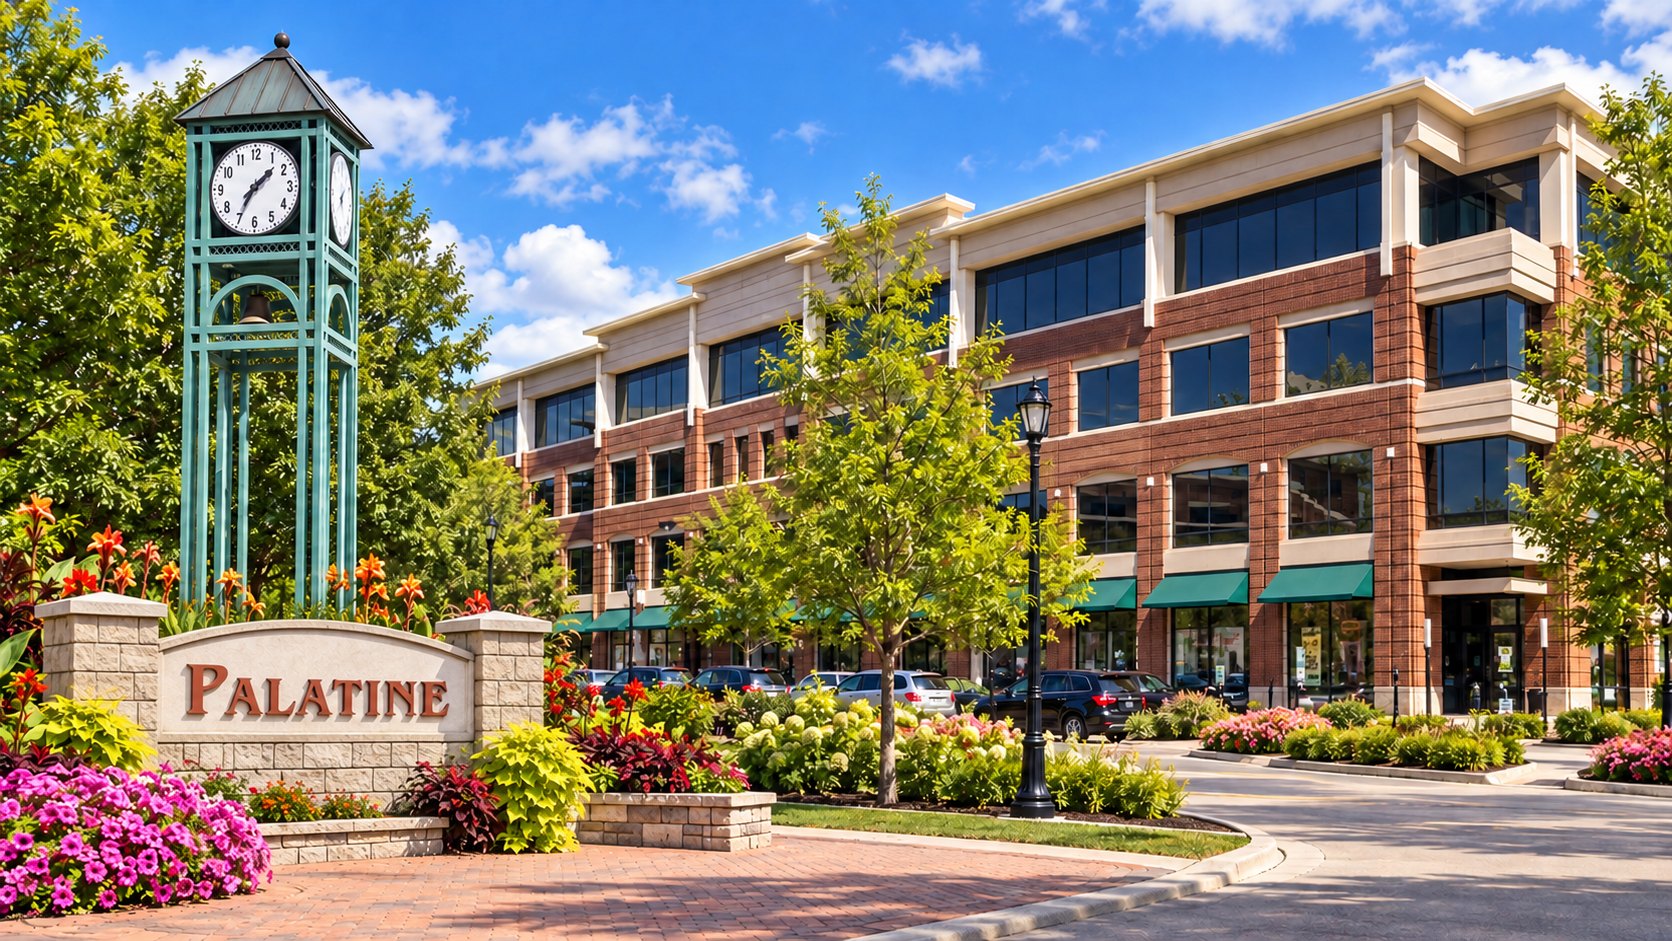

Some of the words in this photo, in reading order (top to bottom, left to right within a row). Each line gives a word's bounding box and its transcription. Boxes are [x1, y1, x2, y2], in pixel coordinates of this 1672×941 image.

[237, 154, 244, 166] 11
[251, 148, 261, 160] 12
[270, 152, 274, 164] 1
[224, 167, 233, 179] 10
[281, 164, 287, 176] 2
[218, 184, 224, 196] 9
[287, 180, 293, 192] 3
[224, 201, 230, 213] 8
[280, 198, 287, 209] 4
[237, 213, 243, 225] 7
[252, 216, 258, 228] 6
[269, 211, 275, 223] 5
[186, 663, 449, 718] PALATINE
